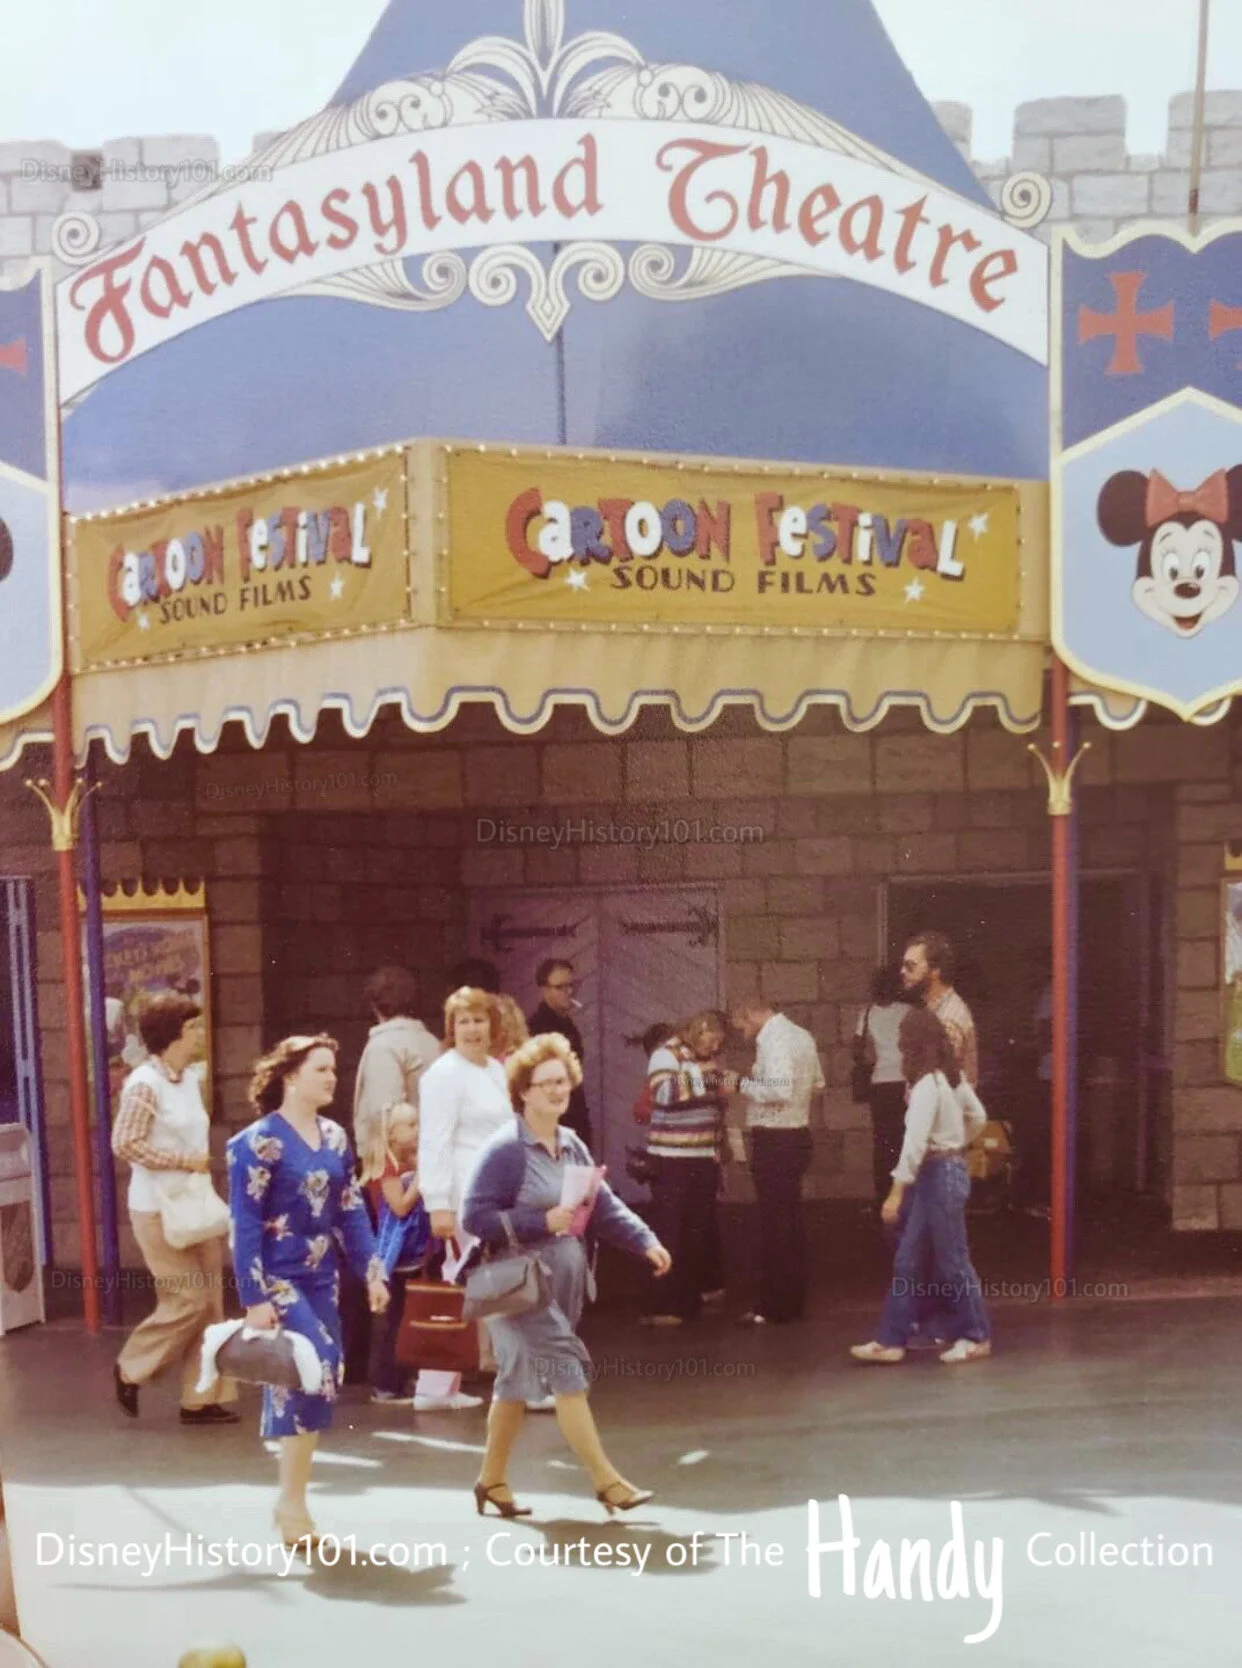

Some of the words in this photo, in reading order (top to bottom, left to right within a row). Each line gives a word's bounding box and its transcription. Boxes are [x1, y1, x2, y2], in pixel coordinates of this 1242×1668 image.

[70, 133, 603, 364] Fantasyland
[655, 138, 1018, 312] Theatre
[159, 592, 228, 625] SOUND
[239, 575, 312, 612] FILMS
[611, 564, 735, 593] SOUND
[757, 570, 876, 596] FILMS
